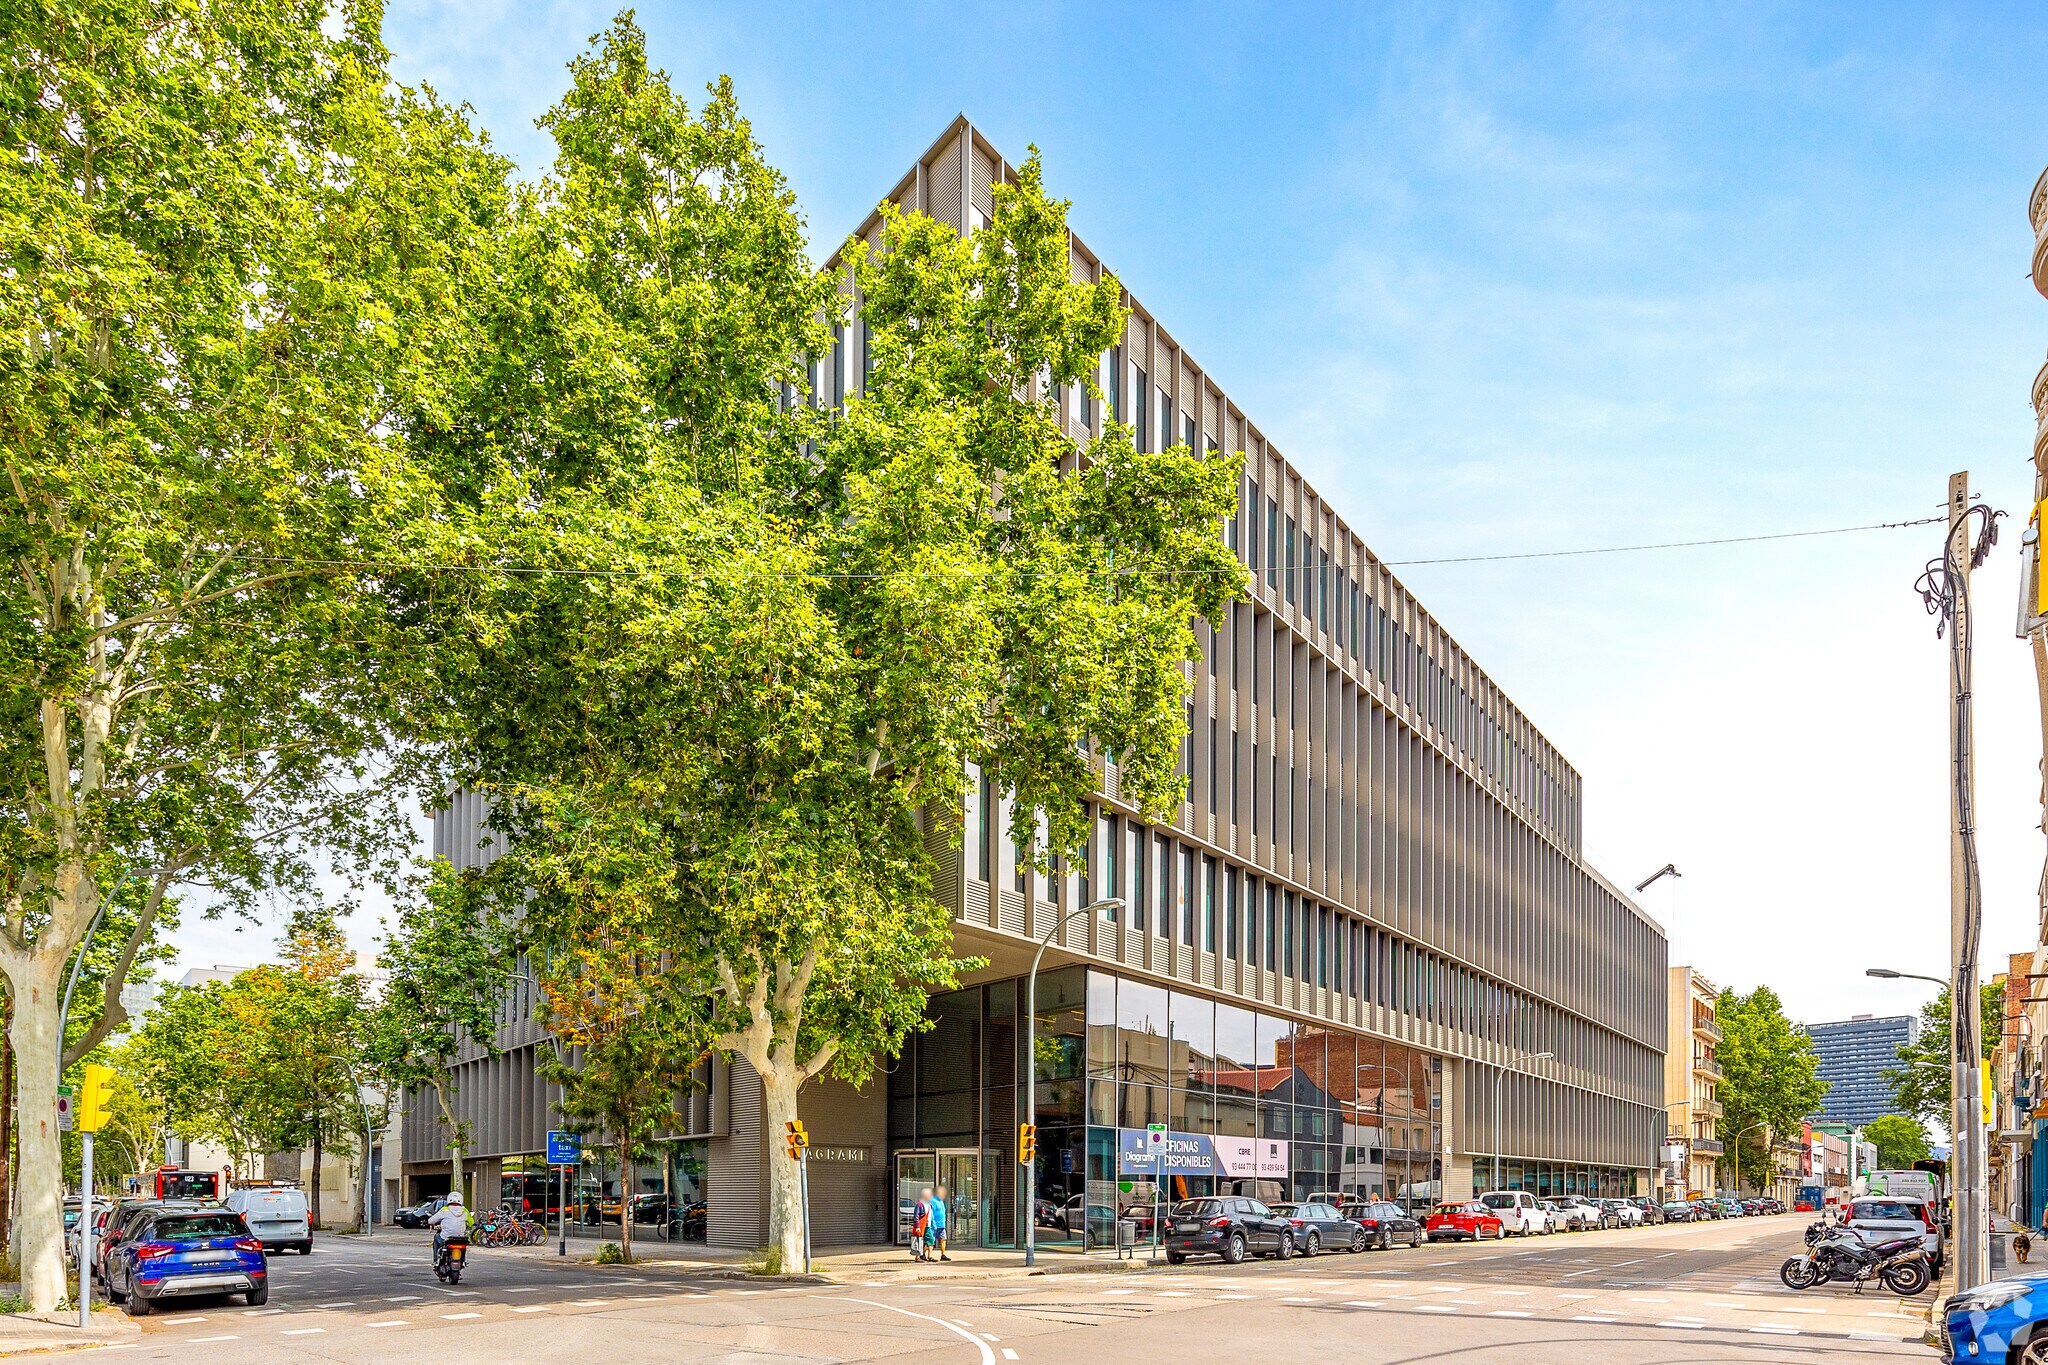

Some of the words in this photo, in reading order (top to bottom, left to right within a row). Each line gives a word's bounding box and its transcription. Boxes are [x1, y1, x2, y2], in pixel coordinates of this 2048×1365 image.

[1165, 1140, 1199, 1153] OFICINAS
[1238, 1148, 1251, 1156] CBRE
[805, 1148, 863, 1160] AGRAMI
[1164, 1154, 1212, 1168] DISPONIBLES
[1274, 1164, 1280, 1172] 54
[1280, 1164, 1285, 1172] 54
